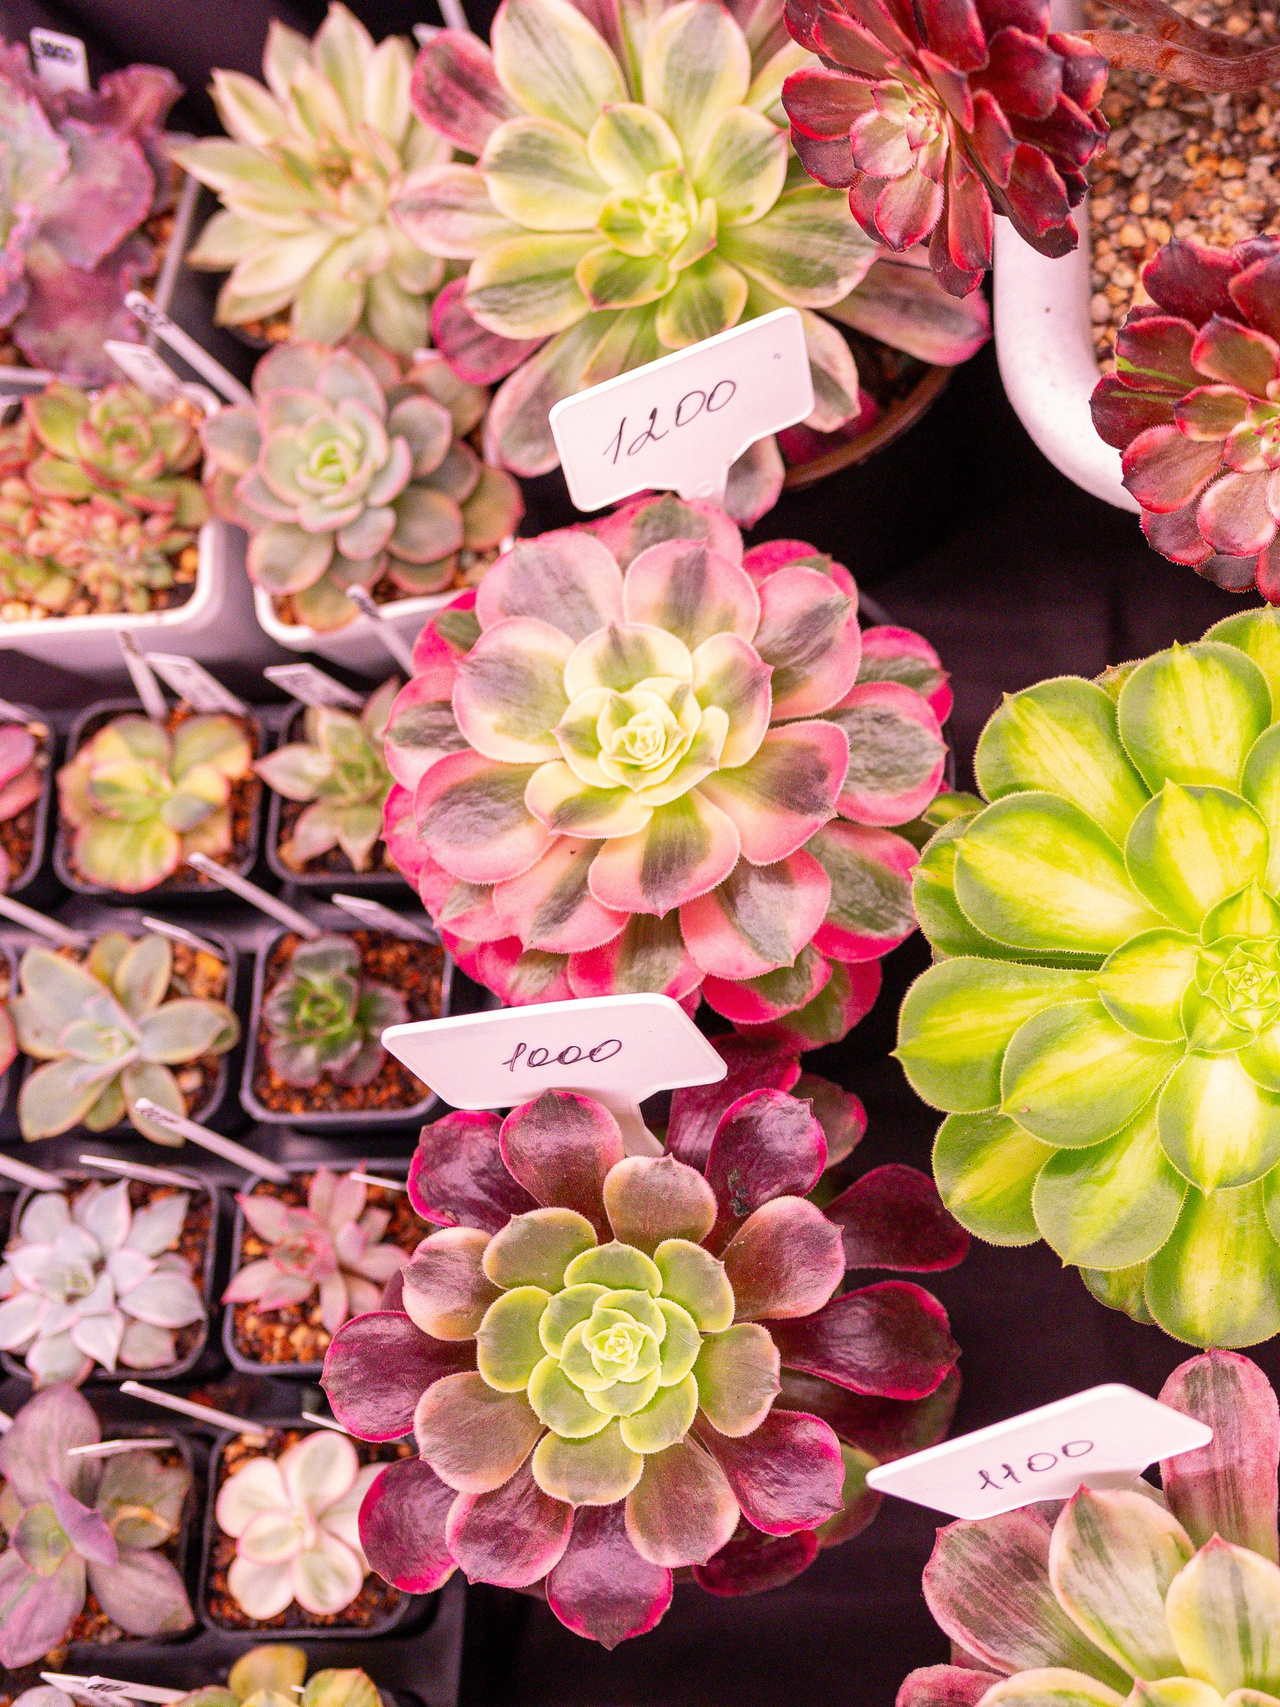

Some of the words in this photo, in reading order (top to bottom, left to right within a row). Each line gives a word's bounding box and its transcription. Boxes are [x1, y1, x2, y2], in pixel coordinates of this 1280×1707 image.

[602, 379, 737, 465] 1200
[501, 1038, 623, 1073] 1000
[977, 1439, 1094, 1491] 1100
